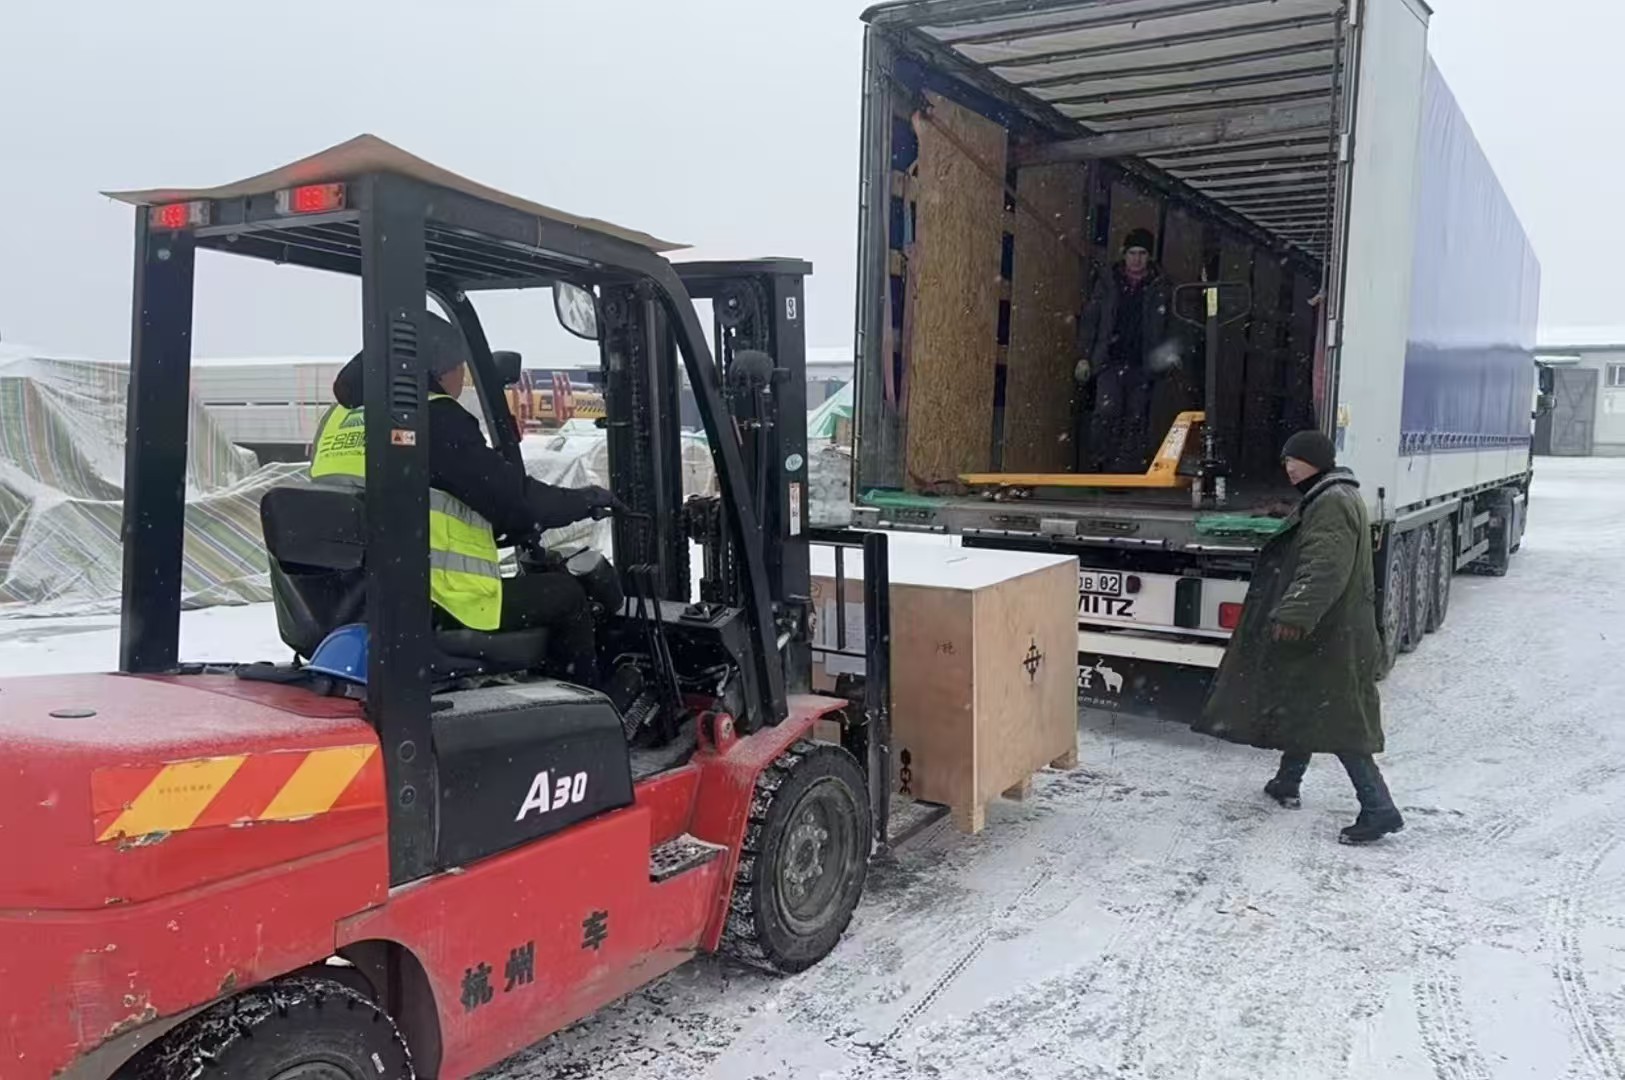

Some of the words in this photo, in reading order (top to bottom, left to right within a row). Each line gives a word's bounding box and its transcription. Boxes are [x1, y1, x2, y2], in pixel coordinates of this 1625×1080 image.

[1100, 575, 1118, 592] 02
[515, 770, 588, 821] A30
[460, 941, 535, 1006] 杭州
[582, 910, 609, 951] 车
